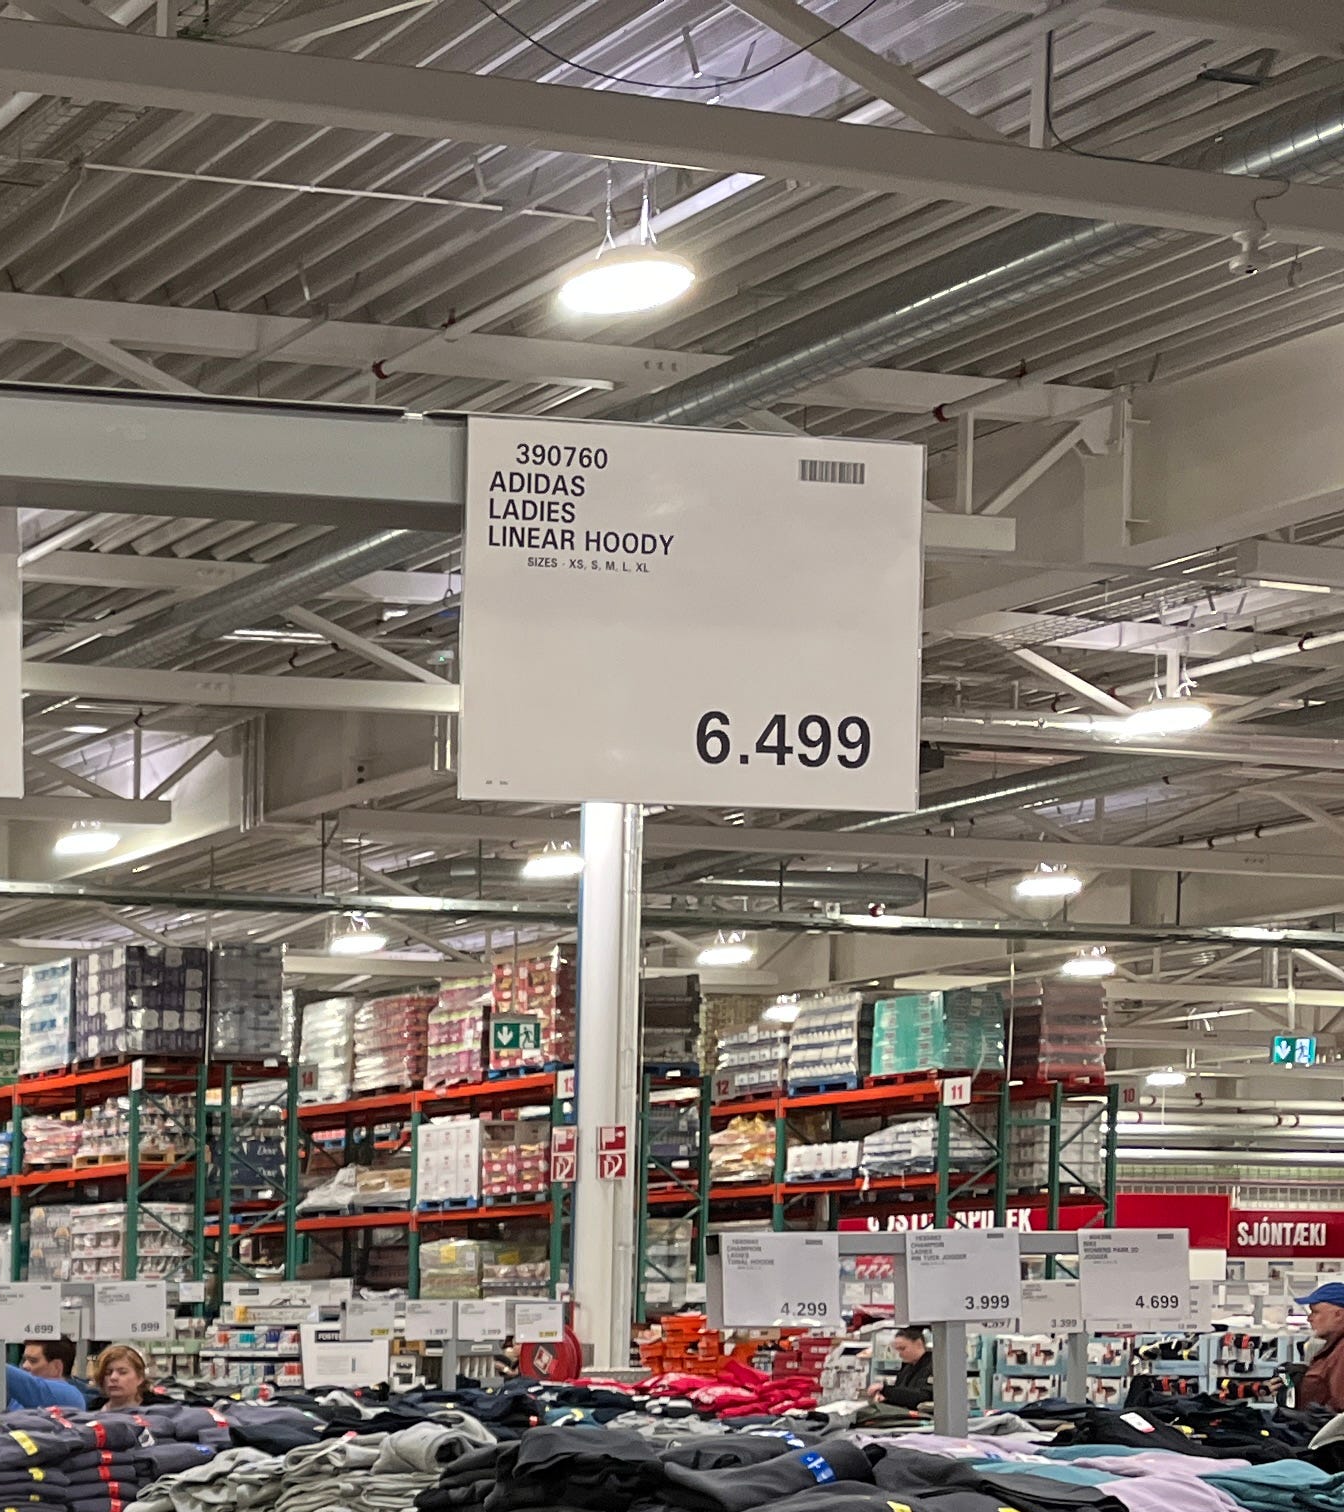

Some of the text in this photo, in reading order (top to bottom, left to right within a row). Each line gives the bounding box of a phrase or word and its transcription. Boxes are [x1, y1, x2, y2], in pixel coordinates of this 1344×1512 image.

[515, 442, 609, 470] 390760
[488, 470, 586, 497] ADIDAS
[488, 497, 576, 524] LADIES
[488, 526, 675, 556] LINEAR HOODY
[526, 556, 558, 570] SIZES
[635, 561, 650, 573] XL
[696, 710, 871, 770] 6.499
[715, 1080, 729, 1096] 12
[950, 1084, 964, 1100] 11
[1122, 1088, 1136, 1103] 10
[1237, 1220, 1327, 1248] SJÓNTÆKI
[780, 1301, 828, 1318] 4.299
[964, 1294, 1011, 1311] 3.999
[1135, 1294, 1180, 1310] 4.699
[23, 1323, 54, 1335] 4.699
[130, 1322, 160, 1333] 5.999
